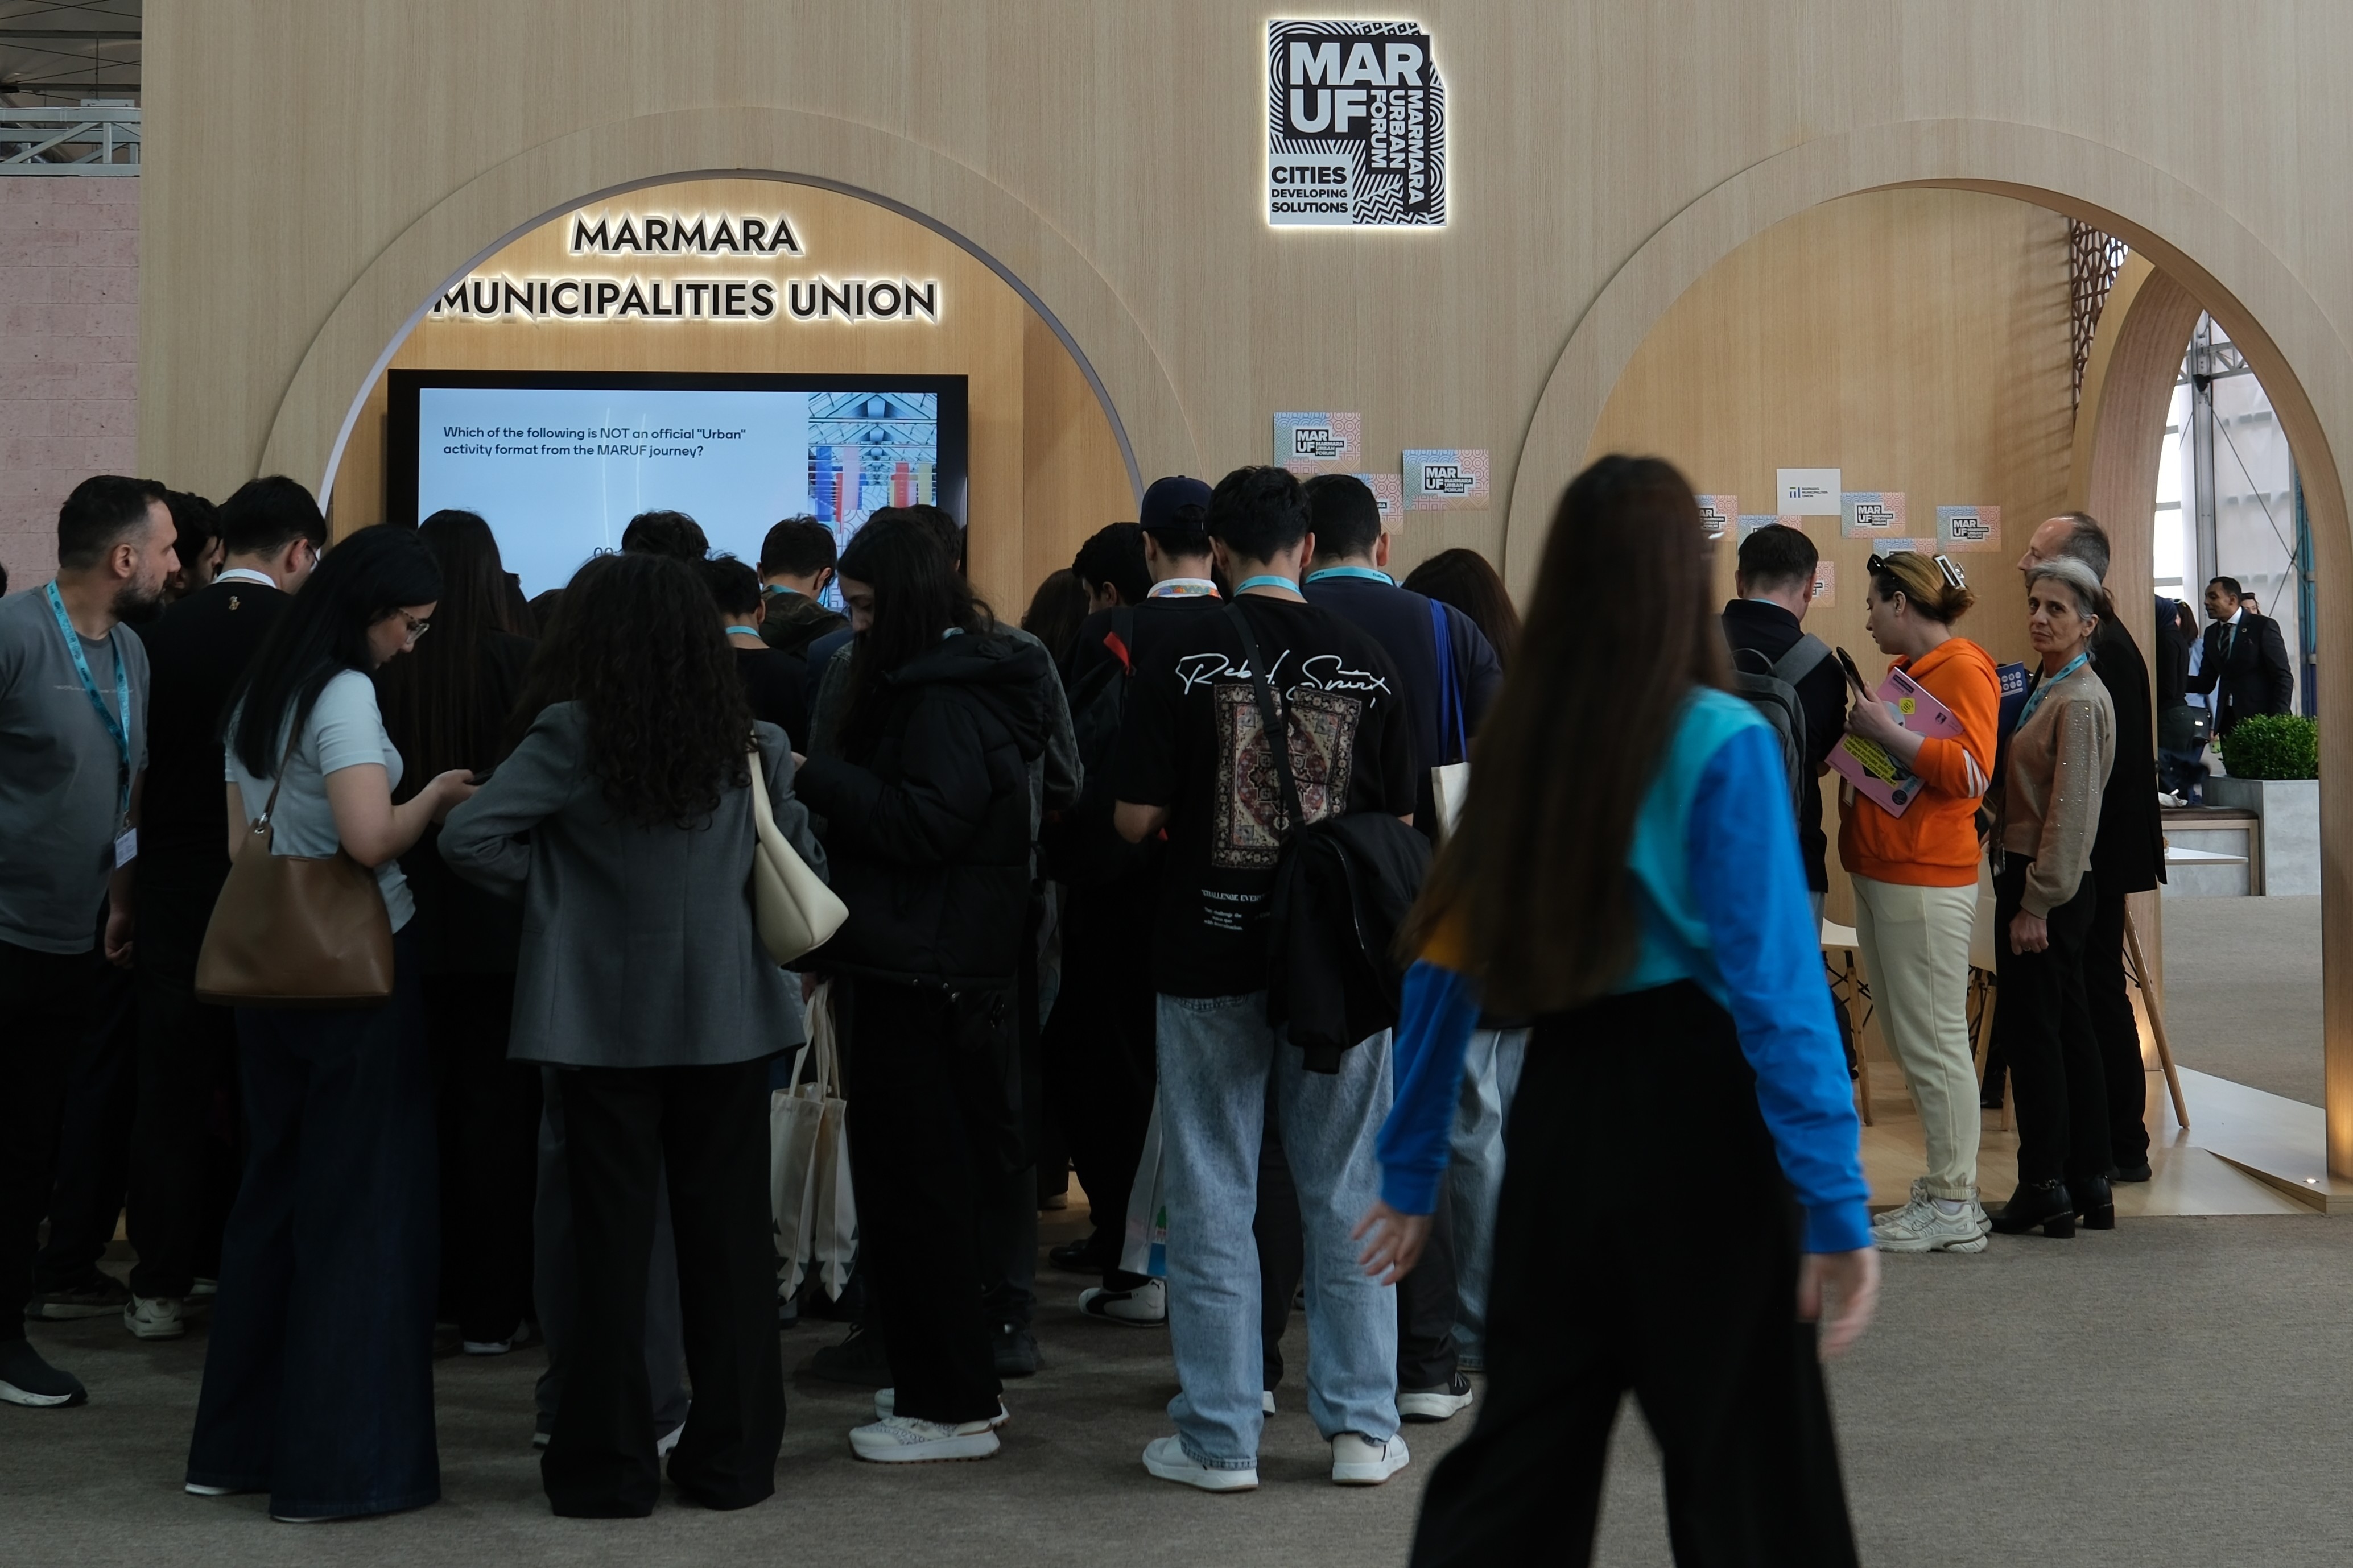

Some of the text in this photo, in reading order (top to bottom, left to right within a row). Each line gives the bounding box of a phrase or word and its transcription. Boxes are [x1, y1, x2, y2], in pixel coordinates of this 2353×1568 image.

[1290, 42, 1423, 86] MAR
[1290, 89, 1367, 133] UF
[1370, 90, 1387, 168] FORUM
[1389, 90, 1405, 168] URBAN
[1408, 90, 1425, 205] MARMARA
[1272, 166, 1347, 184] CITIES
[1272, 189, 1348, 198] DEVELOPING
[1272, 202, 1348, 213] SOLUTIONS
[573, 219, 798, 251] MARMARA
[434, 281, 935, 316] MUNICIPALITIES UNION
[443, 427, 484, 437] Which
[487, 427, 501, 437] of
[503, 427, 524, 437] the
[527, 427, 585, 440] following
[588, 428, 597, 438] is
[600, 428, 630, 438] NOT
[651, 428, 695, 439] official
[1297, 431, 1328, 441] MAR
[443, 444, 704, 458] activity format from the MARUF journey?
[1297, 441, 1315, 452] UF
[1426, 467, 1456, 478] MAR
[1426, 478, 1443, 489] UF
